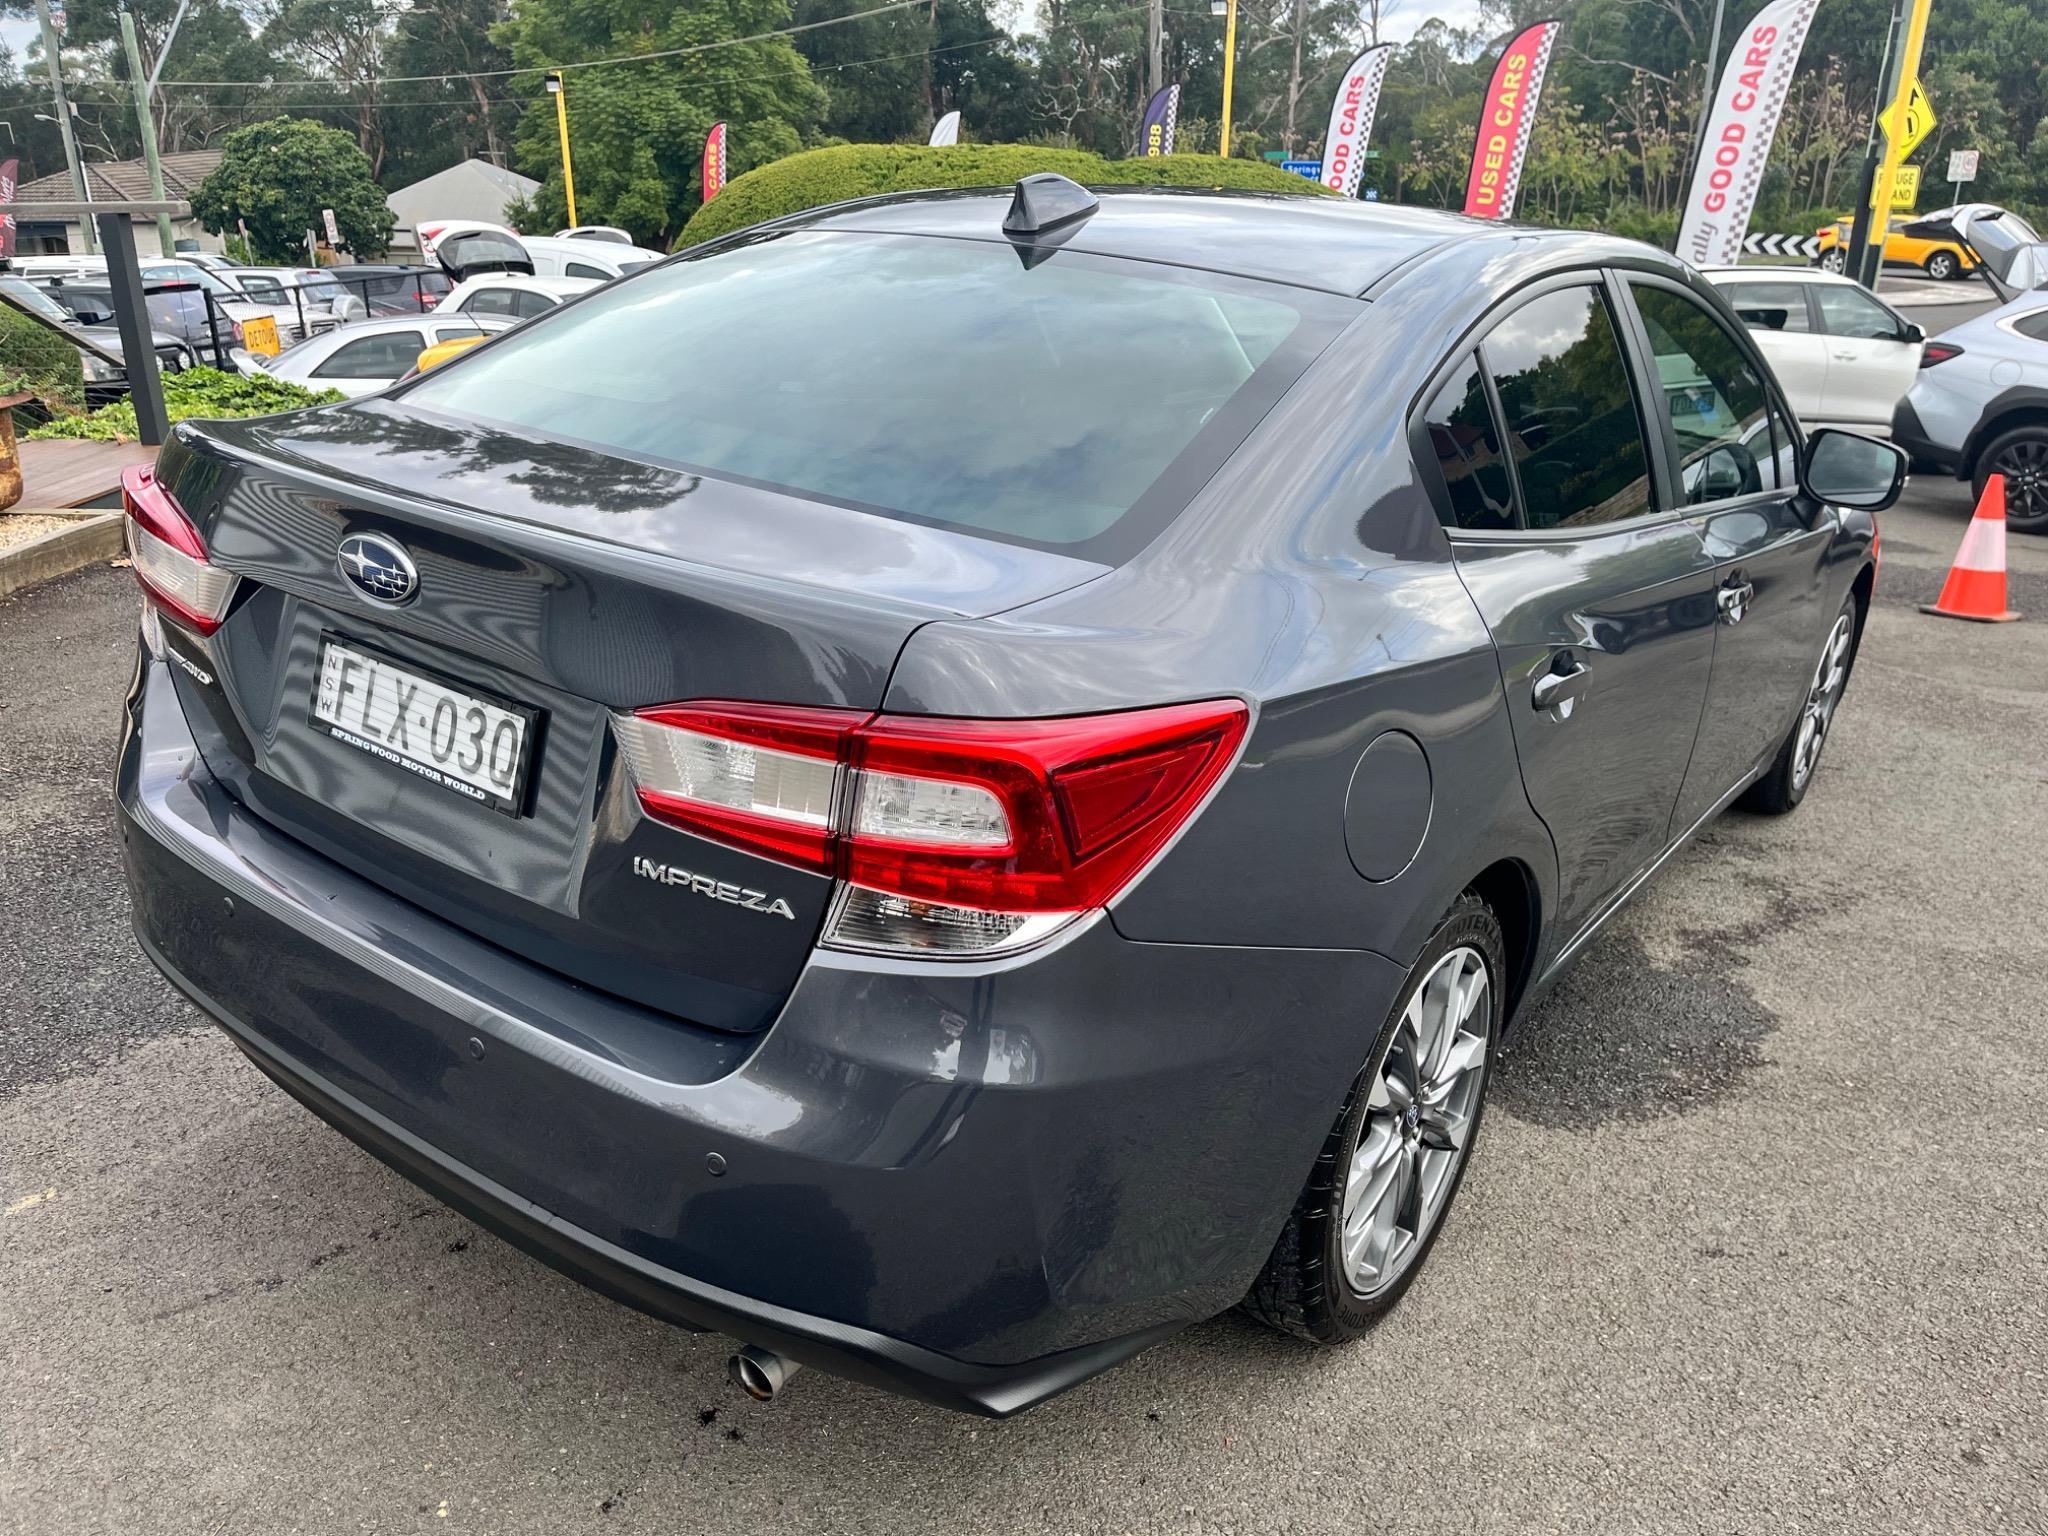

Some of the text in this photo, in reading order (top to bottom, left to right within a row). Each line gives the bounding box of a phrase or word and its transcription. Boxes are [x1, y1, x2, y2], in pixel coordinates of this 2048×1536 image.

[1339, 74, 1365, 136] CARS
[1476, 135, 1507, 205] USED
[1494, 53, 1527, 127] CARS
[1703, 122, 1746, 213] GOOD
[1731, 24, 1778, 112] CARS
[708, 143, 718, 190] CARS
[248, 327, 275, 348] DETOUR
[331, 727, 486, 800] SPRINGWOOD MOTOR WORLD
[633, 855, 796, 920] IMPREZA
